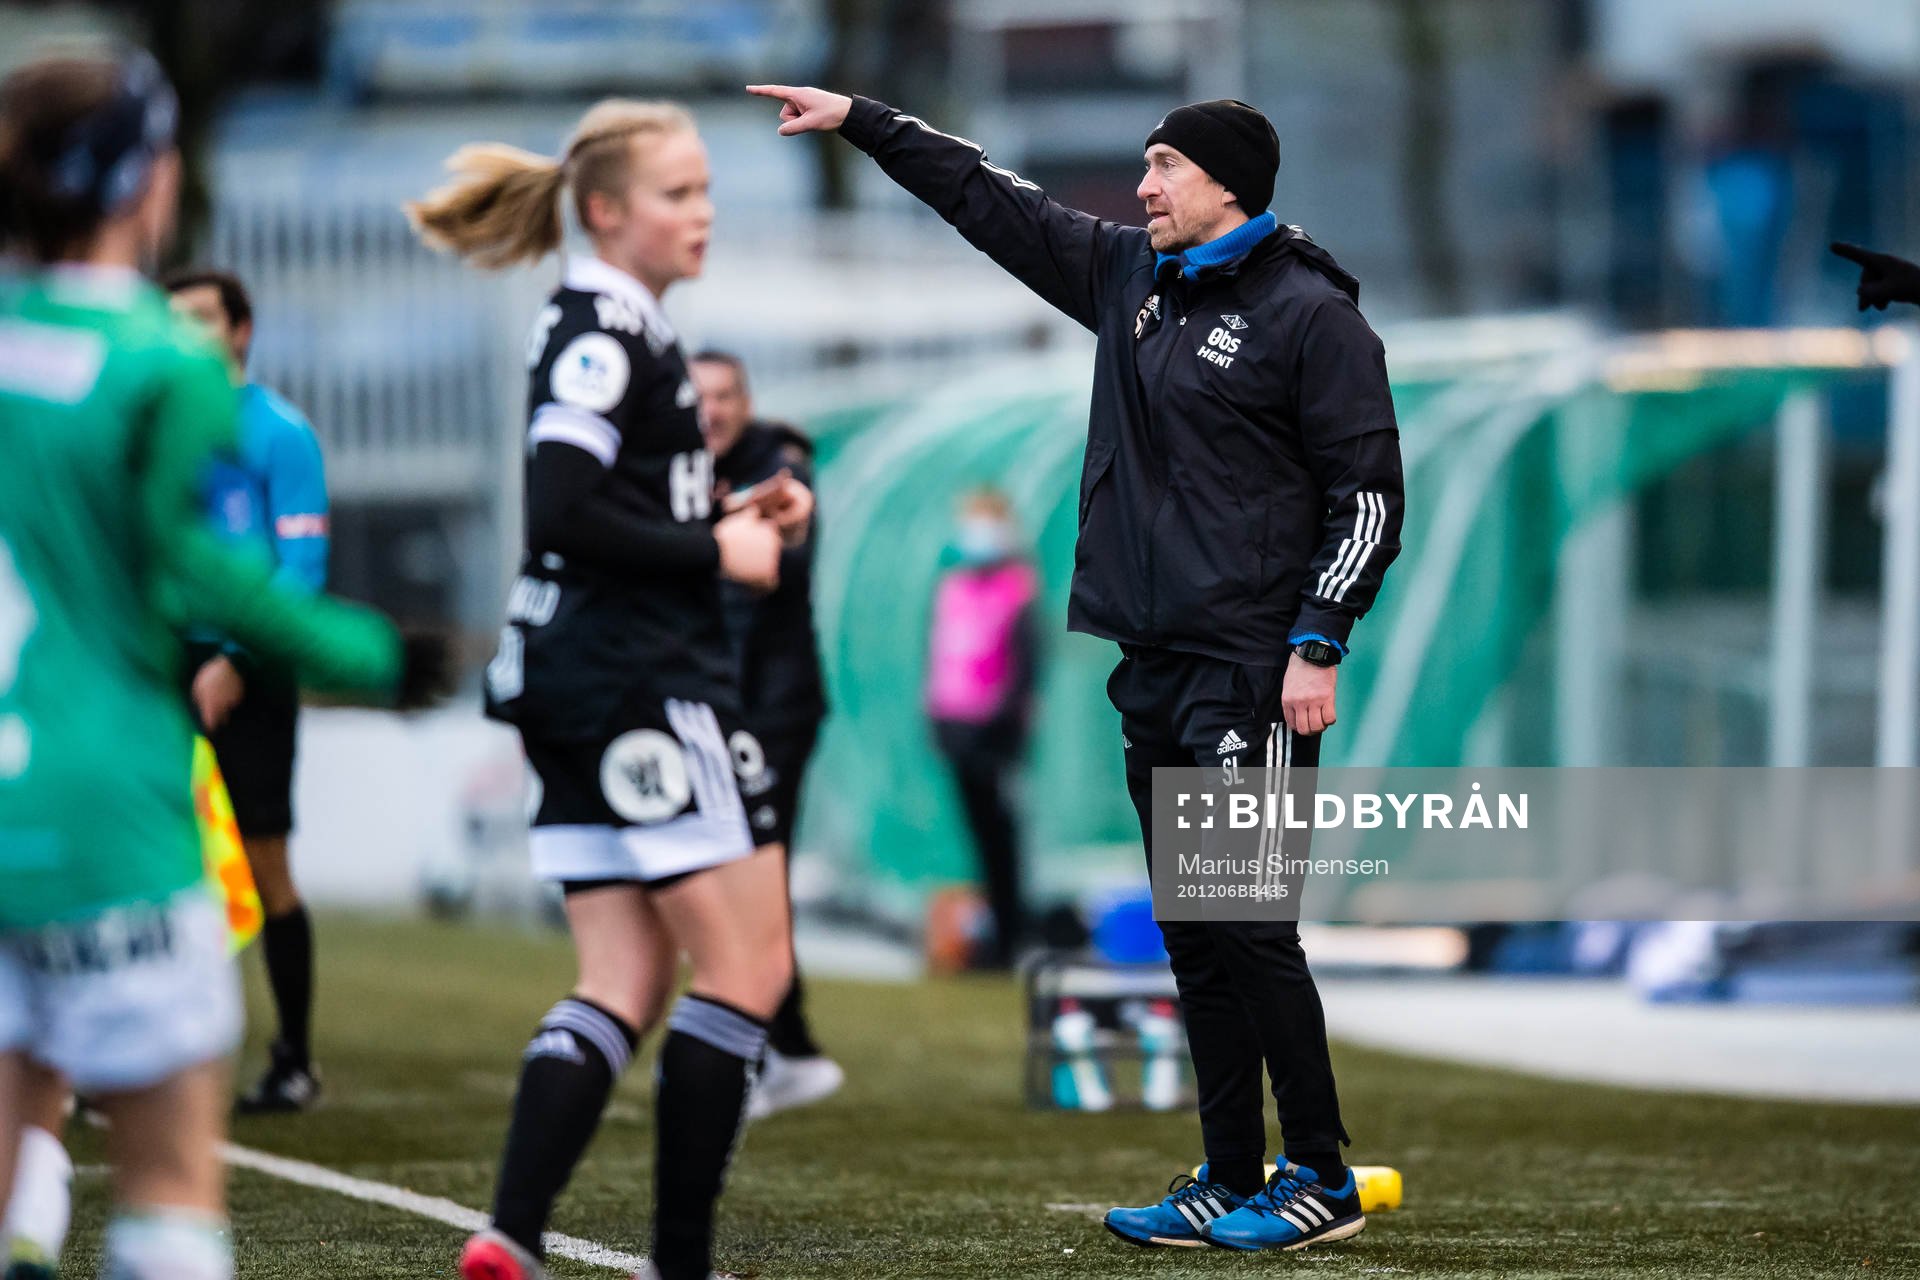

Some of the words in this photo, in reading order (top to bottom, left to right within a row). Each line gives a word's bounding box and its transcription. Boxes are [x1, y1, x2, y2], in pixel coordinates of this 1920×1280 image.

[1197, 345, 1234, 369] HENT
[1216, 740, 1248, 755] adidas
[1222, 755, 1244, 786] SL
